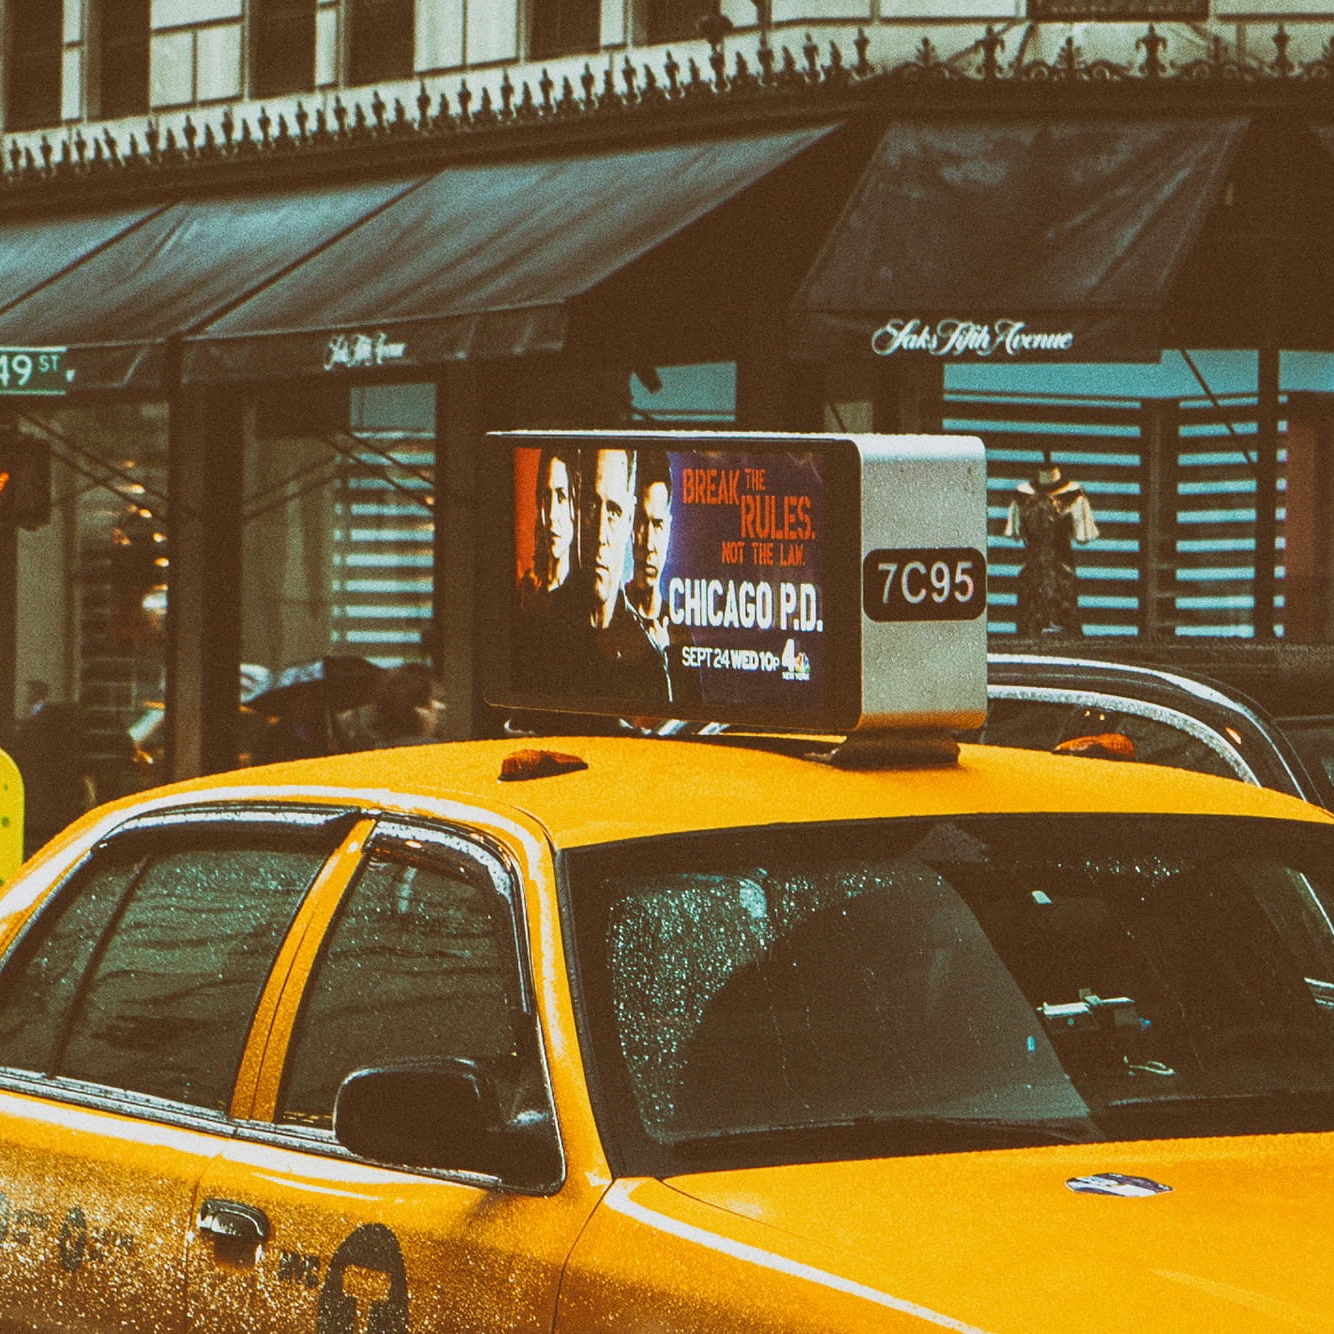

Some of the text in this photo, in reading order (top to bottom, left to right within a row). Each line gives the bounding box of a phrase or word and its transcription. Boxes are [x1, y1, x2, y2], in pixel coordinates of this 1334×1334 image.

[871, 318, 1073, 356] Saks Fifth Avenue
[38, 354, 60, 373] ST
[681, 467, 766, 506] BREAK THE
[740, 495, 816, 540] RULES.
[722, 541, 805, 567] NOT THE LAW.
[877, 561, 974, 604] 7C95
[668, 576, 824, 633] CHICAGO P.D.
[681, 646, 713, 668] SEPT
[713, 647, 730, 669] 24
[730, 649, 759, 672] WED
